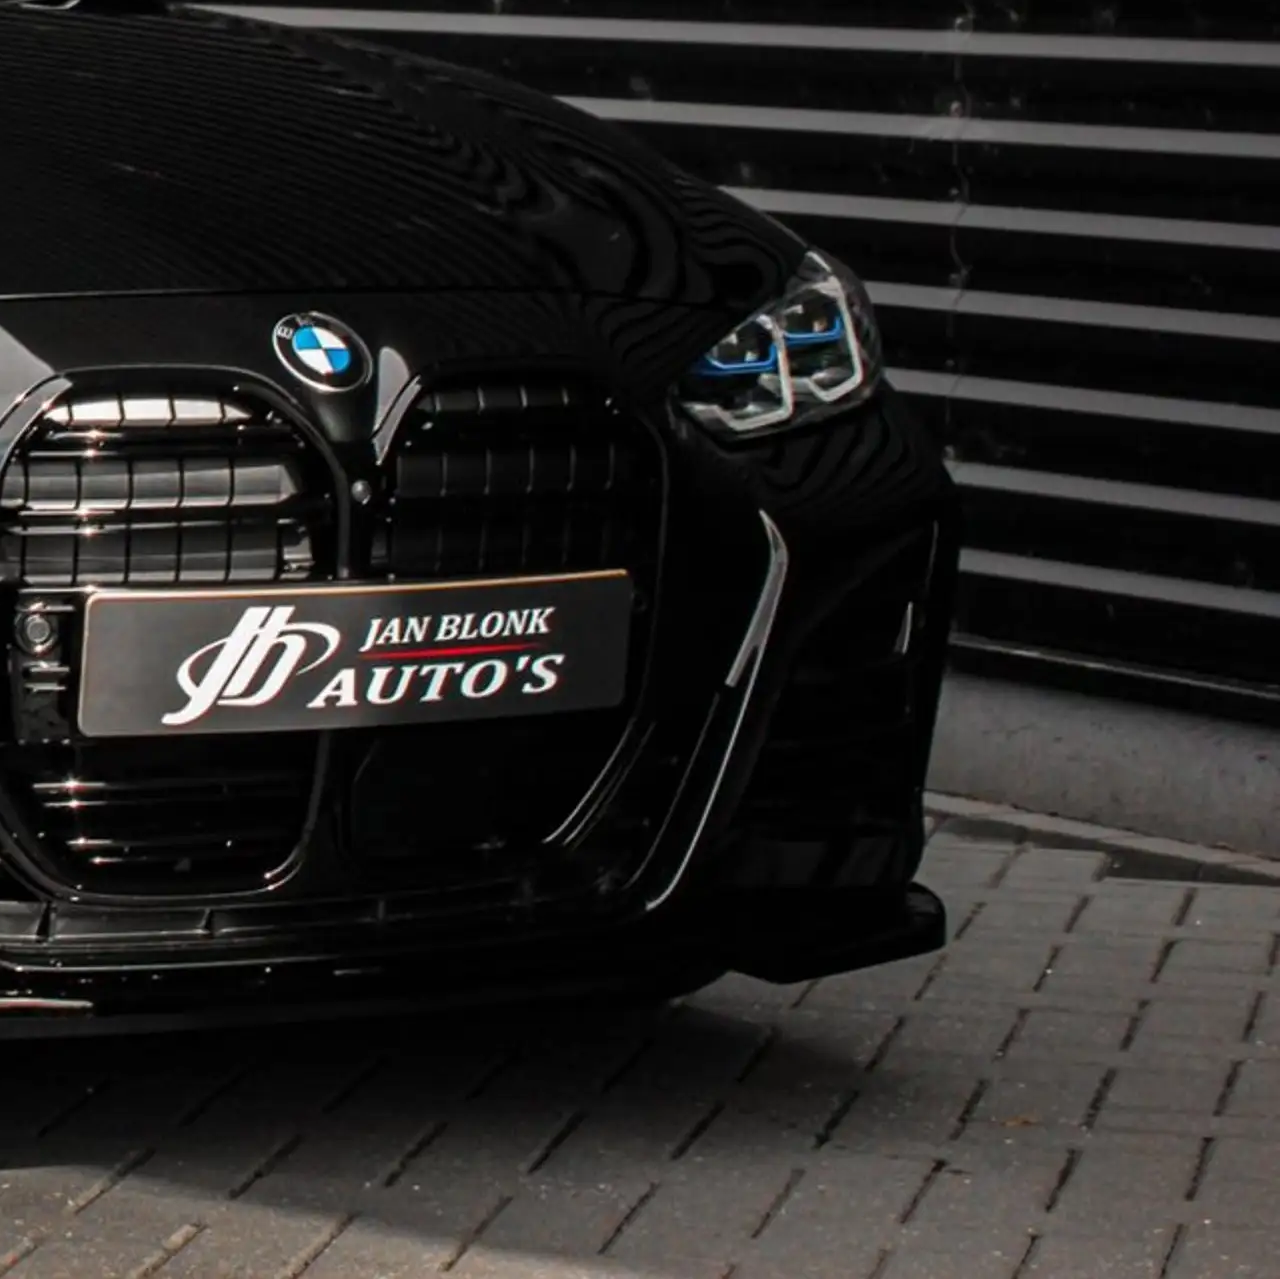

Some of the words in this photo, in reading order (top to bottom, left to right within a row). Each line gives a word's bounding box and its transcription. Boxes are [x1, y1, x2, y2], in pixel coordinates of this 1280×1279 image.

[359, 617, 432, 652] JAN
[435, 607, 556, 641] BLONK
[306, 654, 565, 708] AUTO'S
